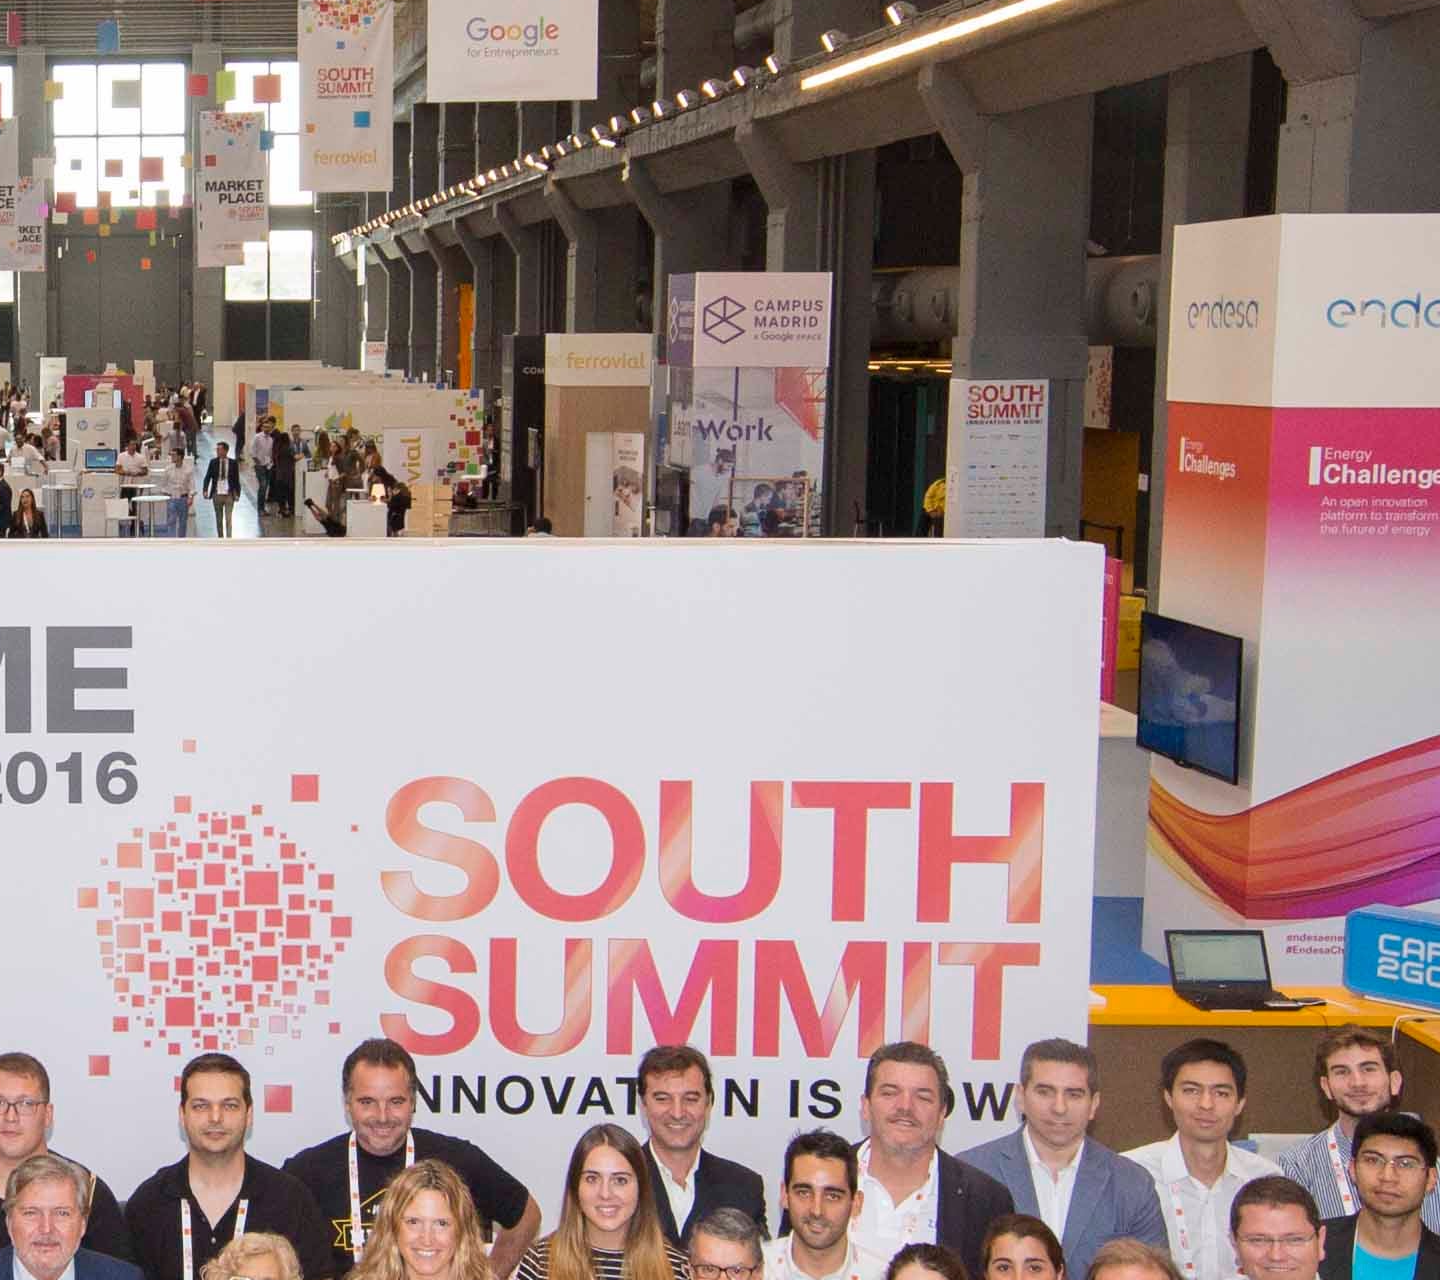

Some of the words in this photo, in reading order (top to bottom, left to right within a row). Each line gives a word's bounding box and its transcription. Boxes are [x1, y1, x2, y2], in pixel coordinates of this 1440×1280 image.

[466, 16, 559, 47] Google
[484, 47, 559, 59] Entrepreneurs
[317, 67, 374, 81] SOUTH
[317, 81, 373, 94] SUMMIT
[314, 149, 377, 165] ferrovial
[205, 180, 264, 193] MARKET
[218, 192, 264, 205] PLACE
[754, 299, 824, 312] CAMPUS
[1187, 295, 1258, 329] endesa
[754, 315, 818, 329] MADRID
[761, 331, 795, 342] Google
[567, 352, 645, 369] ferrovial
[967, 385, 1044, 402] SOUTH
[967, 403, 1043, 418] SUMMIT
[697, 418, 773, 442] Work
[1324, 447, 1372, 461] Energy
[1183, 453, 1237, 480] Challenges
[1321, 496, 1335, 507] An
[1340, 498, 1368, 510] open
[1372, 496, 1428, 507] innovation
[1320, 510, 1368, 523] platform
[1370, 511, 1382, 521] to
[1385, 510, 1439, 521] transform
[1320, 523, 1338, 535] the
[1340, 523, 1376, 535] future
[1377, 524, 1389, 535] of
[1391, 526, 1431, 537] energy
[381, 776, 1045, 924] SOUTH
[379, 934, 1040, 1061] SUMMIT
[789, 1079, 843, 1119] IS
